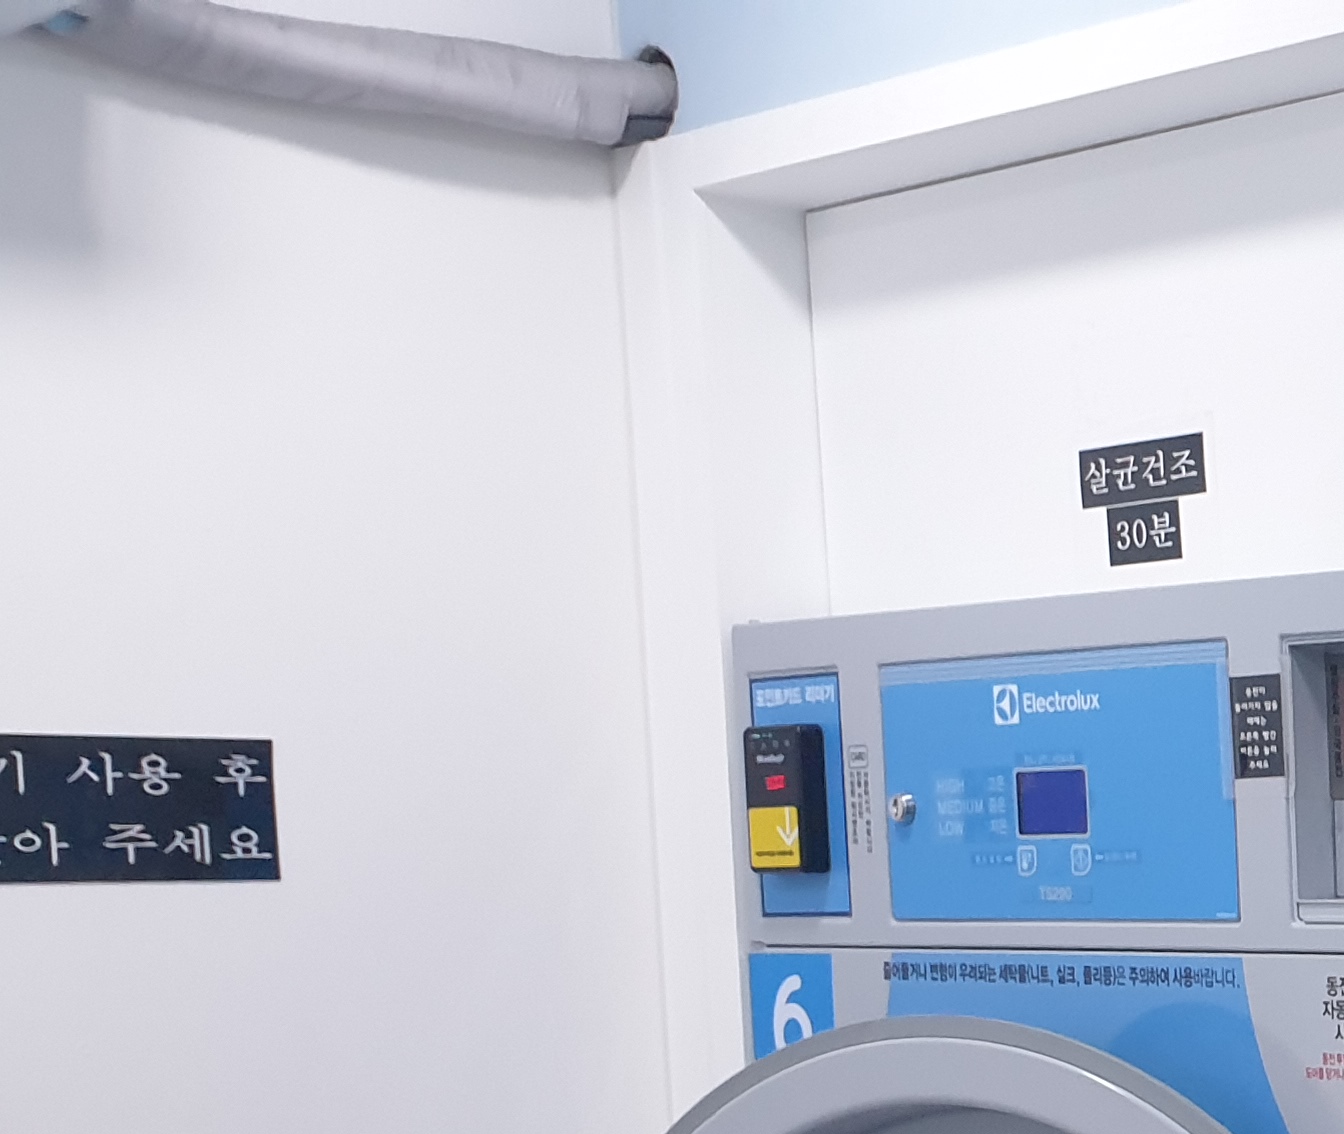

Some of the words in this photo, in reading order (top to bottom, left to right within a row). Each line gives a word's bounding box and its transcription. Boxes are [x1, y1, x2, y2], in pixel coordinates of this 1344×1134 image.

[1084, 449, 1198, 495] 살균건조
[1116, 511, 1176, 550] 30분
[1023, 690, 1100, 713] Electrolux
[66, 750, 182, 797] 사용
[213, 753, 268, 796] 후
[0, 822, 70, 866] 아
[102, 822, 273, 864] 주세요
[773, 974, 813, 1050] 6
